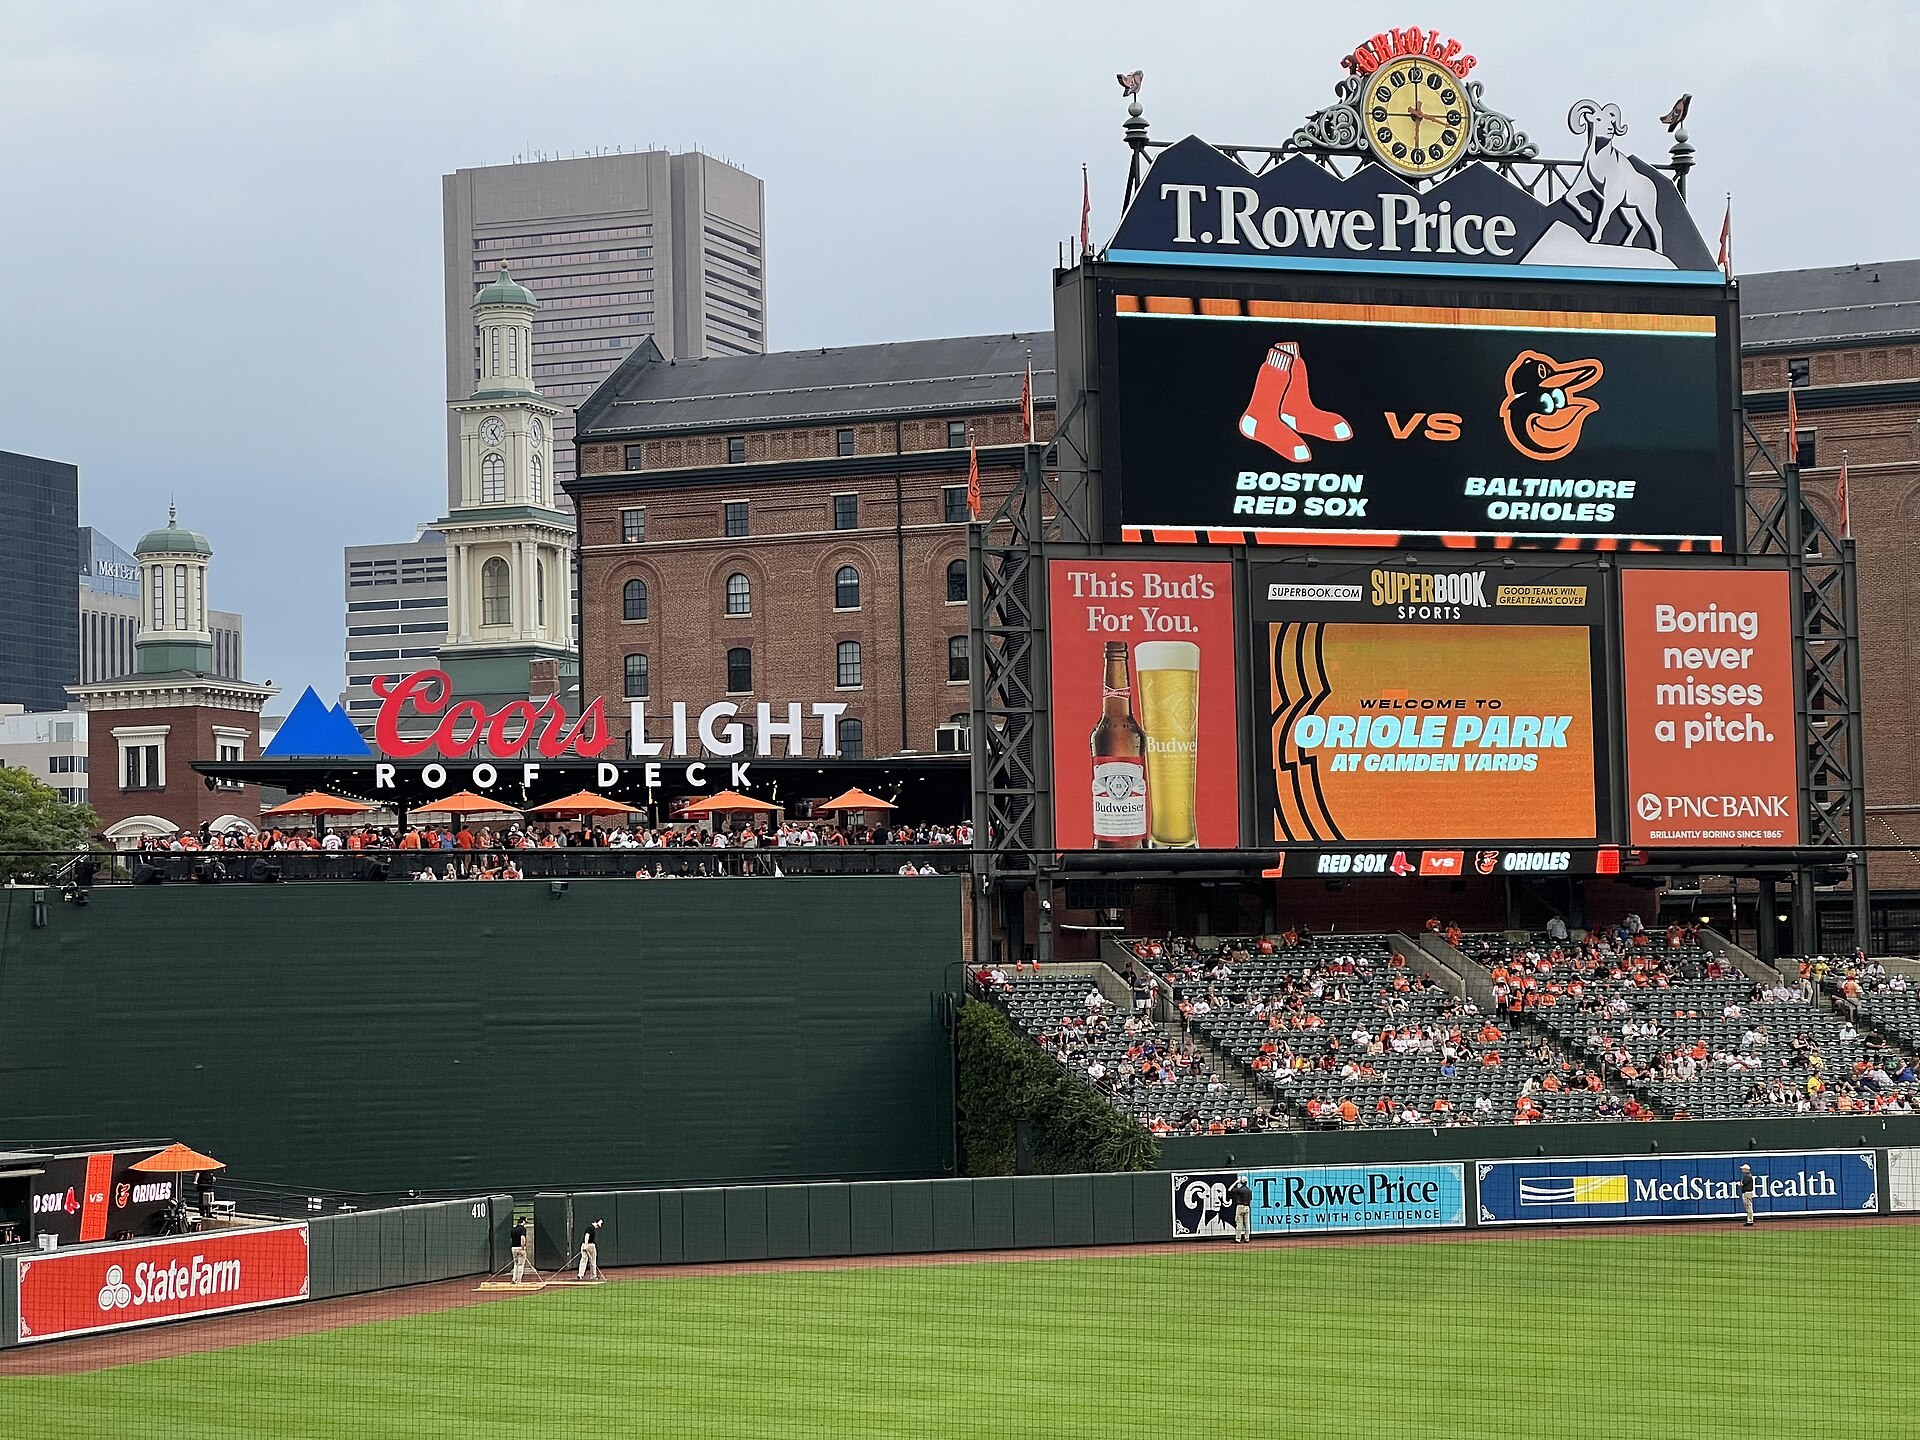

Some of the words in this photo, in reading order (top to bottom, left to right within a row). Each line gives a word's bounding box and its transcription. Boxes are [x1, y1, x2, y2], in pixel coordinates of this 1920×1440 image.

[1353, 26, 1477, 79] ORIOLES
[1392, 73, 1404, 86] 11
[1410, 69, 1422, 80] 12
[1431, 76, 1438, 88] 1
[1378, 87, 1390, 101] 10
[1443, 91, 1454, 103] 2
[1374, 110, 1385, 118] 9
[1449, 113, 1460, 122] 3
[1379, 131, 1390, 140] 8
[1445, 133, 1455, 144] 4
[1396, 145, 1405, 158] 7
[1414, 150, 1422, 163] 6
[1432, 146, 1441, 158] 5
[1383, 412, 1462, 441] VS
[1236, 471, 1363, 493] BOSTON
[1464, 477, 1636, 500] BALTIMORE
[1233, 495, 1302, 516] RED
[1303, 496, 1369, 517] SOX
[1487, 501, 1615, 522] ORIOLES
[99, 560, 120, 578] M&T
[1067, 572, 1134, 598] This
[1142, 573, 1214, 599] Bud's
[1271, 587, 1361, 598] SUPERBOOK.COM
[1371, 569, 1487, 608] SUPERBOOK
[1500, 596, 1526, 604] GREAT
[1528, 596, 1552, 604] TEAMS
[1555, 596, 1584, 604] COVER
[1086, 606, 1133, 632] For
[1139, 607, 1199, 633] You.
[1398, 606, 1461, 619] SPORTS
[1656, 603, 1758, 640] Boring
[1664, 647, 1754, 669] never
[1656, 675, 1763, 706] misses
[371, 668, 617, 758] Coors
[630, 701, 849, 756] LIGHT
[1360, 699, 1467, 709] WELCOME
[1476, 699, 1503, 709] TO
[1294, 715, 1448, 749] ORIOLE
[1452, 715, 1573, 748] PARK
[1655, 720, 1676, 742] a
[1684, 712, 1774, 748] pitch.
[1330, 754, 1362, 772] AT
[1364, 754, 1461, 772] CAMDEN
[1464, 754, 1539, 772] YARDS
[376, 763, 540, 788] ROOF
[597, 762, 752, 788] DECK
[1095, 801, 1144, 813] Budweiser
[1650, 830, 1701, 839] BRILLIANTLY
[1702, 830, 1736, 838] BORING
[1737, 830, 1762, 838] SINCE
[1318, 855, 1350, 873] RED
[1352, 854, 1388, 873] SOX
[1430, 857, 1455, 867] VS
[1504, 851, 1571, 871] ORIOLES
[1634, 1174, 1741, 1202] MedStar
[1752, 1170, 1838, 1198] Health
[41, 1192, 64, 1212] SOX
[89, 1192, 104, 1202] VS
[132, 1182, 172, 1203] ORIOLES
[471, 1203, 486, 1218] 410
[1261, 1214, 1310, 1225] INVEST
[1316, 1212, 1349, 1223] WITH
[1354, 1209, 1440, 1221] CONFIDENCE
